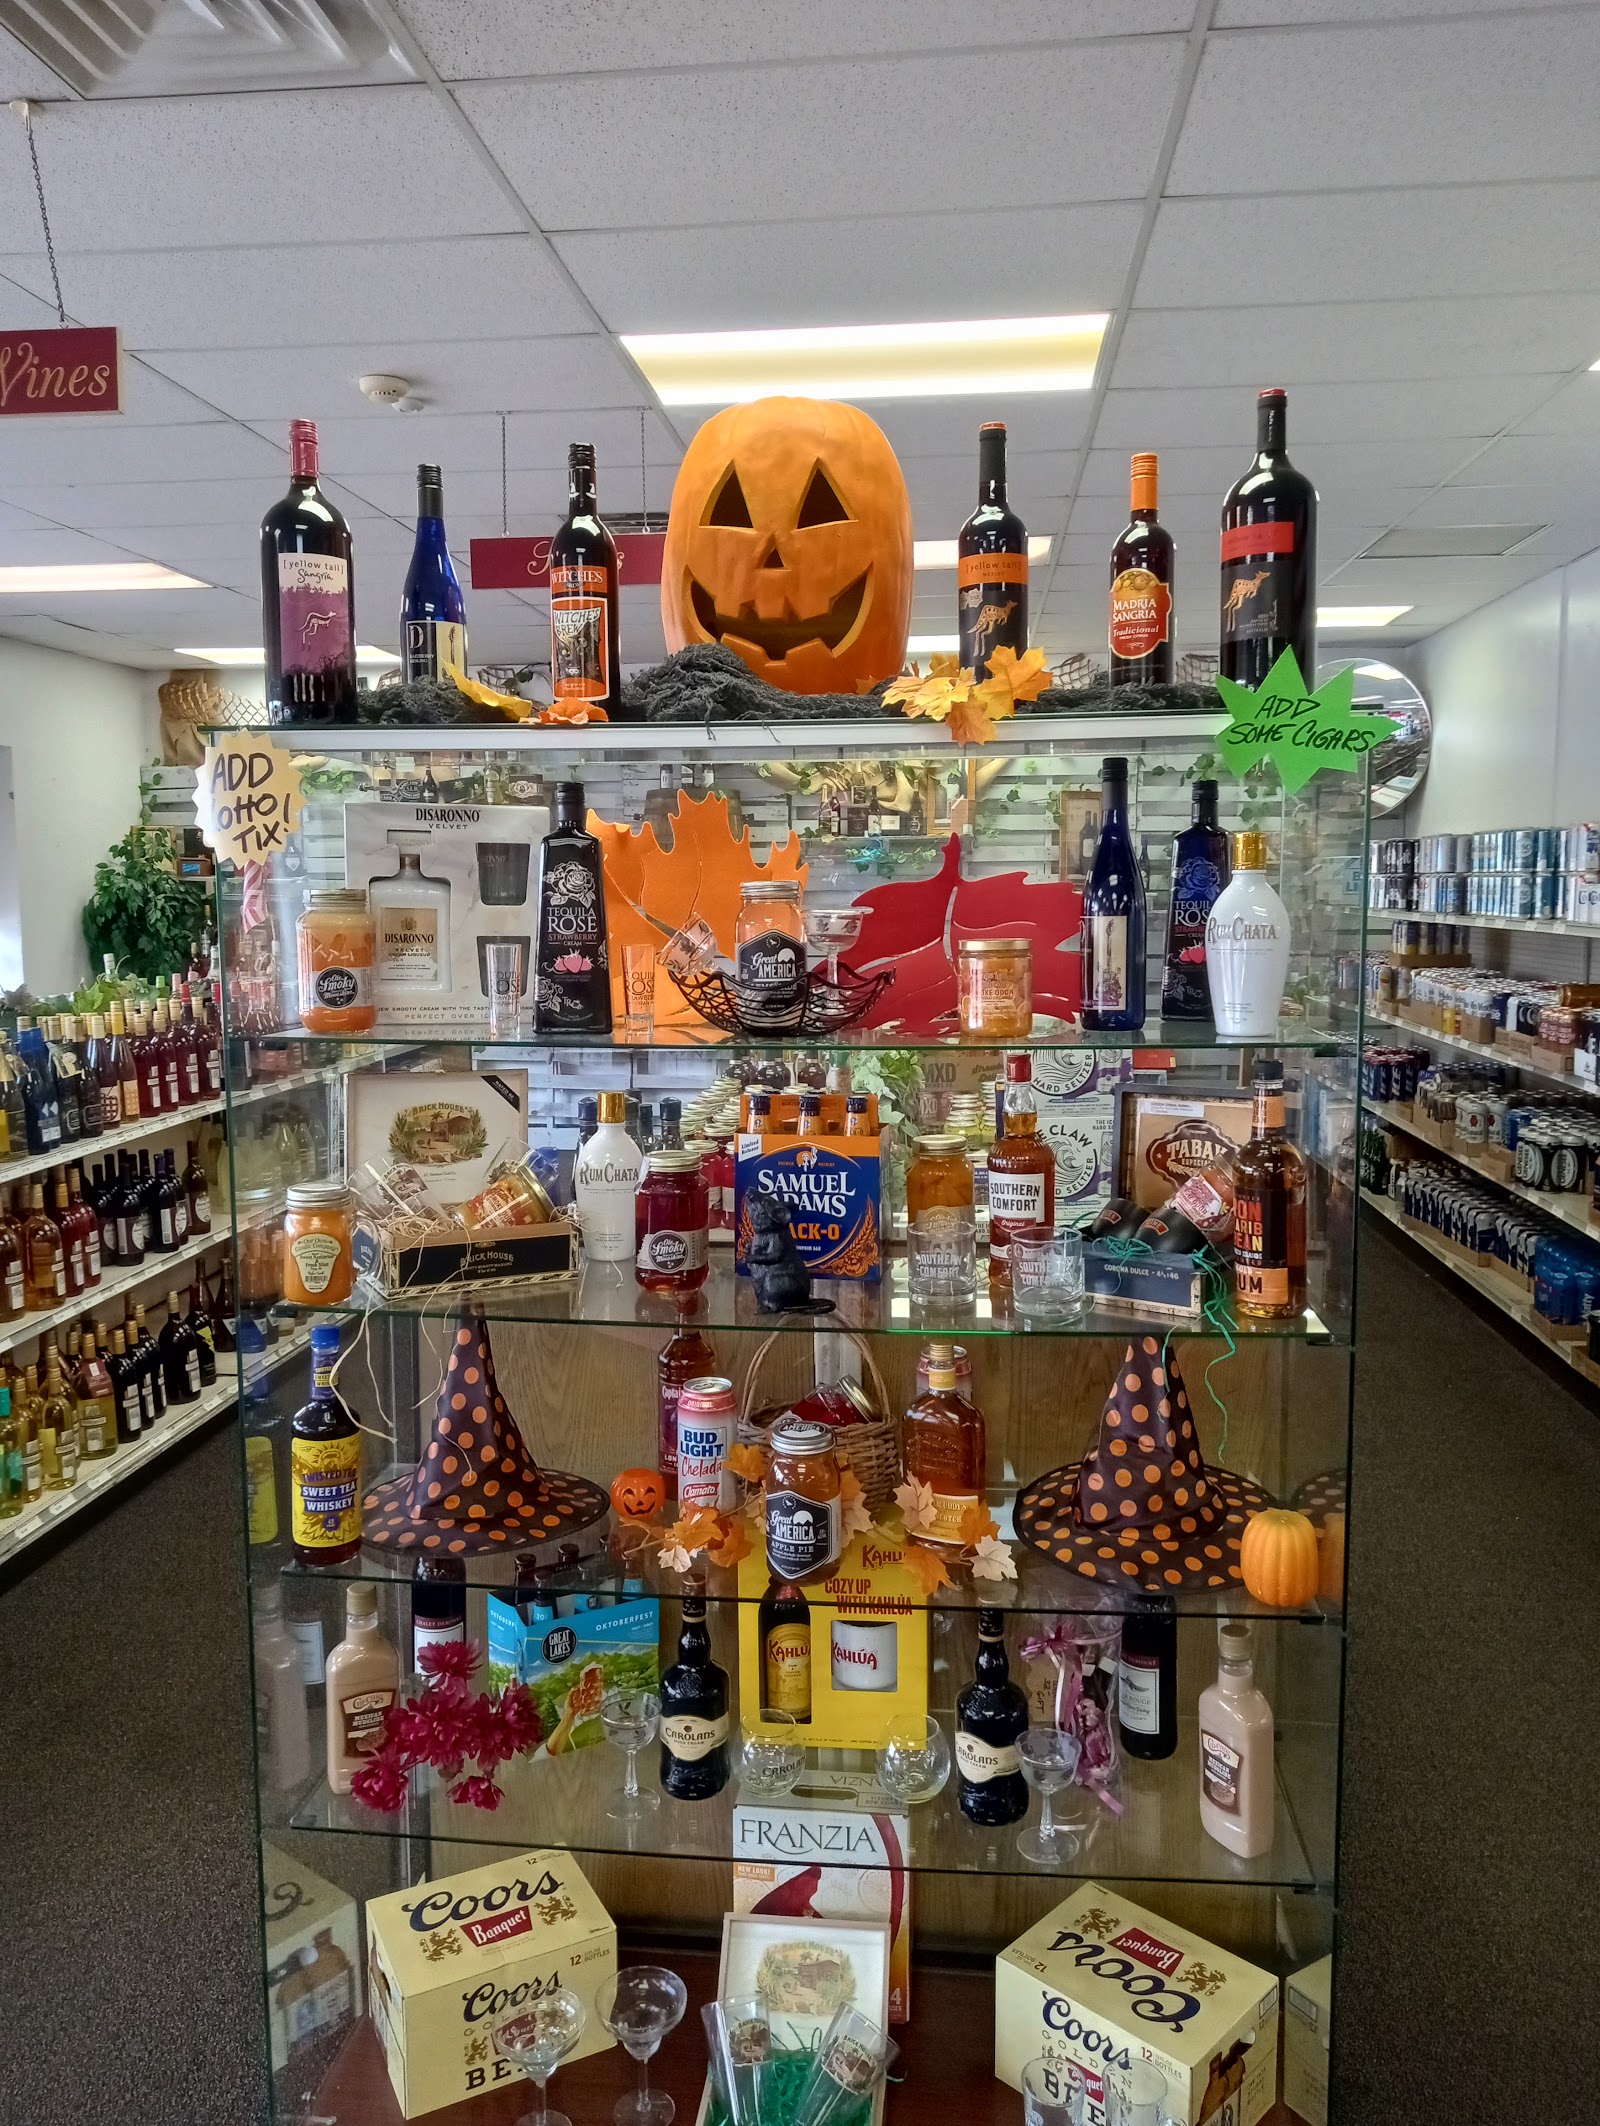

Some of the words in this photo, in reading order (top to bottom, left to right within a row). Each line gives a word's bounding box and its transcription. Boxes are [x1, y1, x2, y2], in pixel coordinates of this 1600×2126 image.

[297, 569, 333, 583] Sangria
[1113, 598, 1157, 612] MADRIA
[1112, 609, 1157, 623] SANGRIA
[408, 625, 424, 648] D
[1113, 625, 1159, 637] Tradicional
[1254, 695, 1321, 719] ADD
[1227, 723, 1297, 745] SOME
[1292, 719, 1375, 752] CIGARS
[211, 752, 274, 794] ADD
[415, 808, 479, 823] DISARONNO
[547, 907, 596, 917] TEQUILA
[1174, 901, 1211, 910] TEQUIL
[547, 916, 598, 934] ROSE
[384, 933, 434, 944] DISARONNO
[750, 952, 778, 970] Great
[758, 964, 796, 977] AMERICA
[318, 977, 356, 992] Smoky
[1033, 1077, 1060, 1092] HARD
[1064, 1054, 1093, 1090] SELTZER
[412, 1102, 437, 1116] BRICK
[438, 1101, 465, 1113] HOUSE
[1049, 1124, 1092, 1148] CLAW
[757, 1169, 856, 1197] SAMUEL
[1067, 1157, 1093, 1194] SELTZER
[990, 1182, 1041, 1197] SOUTHERN
[992, 1199, 1038, 1211] COMFORT
[1001, 1219, 1026, 1227] Original
[1235, 1218, 1263, 1235] ARIB
[651, 1241, 686, 1255] Smoky
[1234, 1233, 1263, 1252] EAN
[487, 1250, 514, 1261] HOUSE
[1130, 1267, 1149, 1276] DULCE
[662, 1385, 681, 1400] Captai
[684, 1429, 718, 1445] BUD
[680, 1440, 724, 1457] LIGHT
[682, 1456, 722, 1477] Chelada
[302, 1470, 340, 1483] TWISTED
[342, 1468, 357, 1479] TEA
[302, 1486, 337, 1496] SWEET
[340, 1480, 357, 1491] TEA
[684, 1485, 717, 1499] Clamato
[306, 1497, 353, 1511] WHISKEY
[770, 1509, 793, 1525] Great
[775, 1525, 815, 1541] AMERICA
[771, 1541, 795, 1552] APPLE
[798, 1545, 814, 1553] PIE
[825, 1578, 854, 1594] COZY
[856, 1580, 871, 1595] UP
[836, 1595, 870, 1615] WITH
[595, 1611, 654, 1632] OKTOBERFEST
[549, 1629, 571, 1646] GREAT
[550, 1642, 571, 1657] LAKES
[768, 1639, 811, 1663] KAHLÚ
[354, 1711, 382, 1721] MEXICAN
[665, 1727, 715, 1741] CAROLANS
[740, 1818, 878, 1855] FRANZIA
[525, 1857, 538, 1866] 12
[737, 1865, 751, 1874] NEW
[752, 1866, 771, 1876] LOOK!
[401, 1870, 564, 1932] Coors
[471, 1909, 527, 1945] Banquet
[570, 1955, 582, 1967] 12
[584, 1949, 610, 1963] BOTTLES
[1116, 1936, 1180, 1970] Banquet
[1033, 1960, 1048, 1973] 12
[1047, 1930, 1201, 2033] Coors
[462, 1970, 562, 2023] Coors
[1042, 1990, 1133, 2071] Coors
[1141, 2046, 1154, 2062] 12
[1154, 2060, 1183, 2080] BOTTLES
